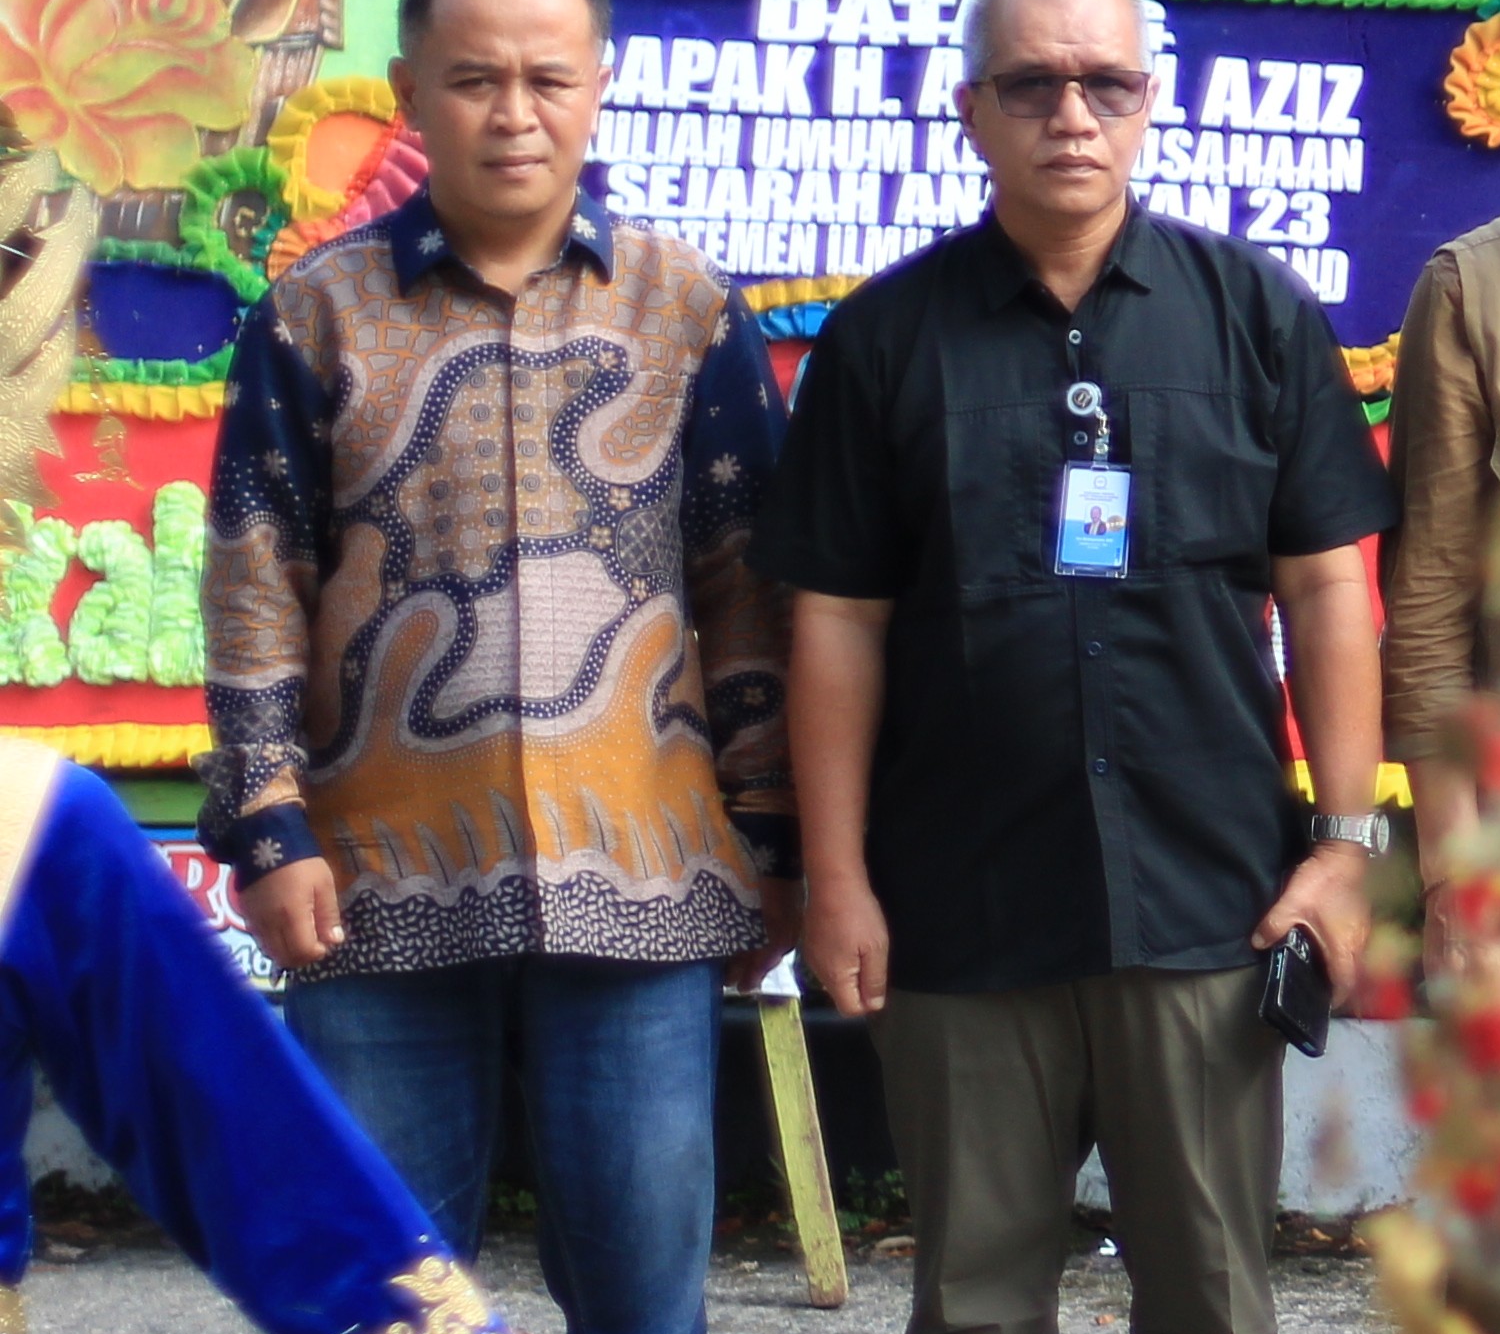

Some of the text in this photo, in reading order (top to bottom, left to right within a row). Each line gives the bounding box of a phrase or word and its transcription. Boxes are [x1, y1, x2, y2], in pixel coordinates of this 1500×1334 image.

[830, 45, 902, 117] H.
[1200, 56, 1364, 136] AZIZ
[751, 117, 914, 173] UMUM
[605, 163, 881, 223] SEJARAH
[1246, 188, 1331, 247] 23
